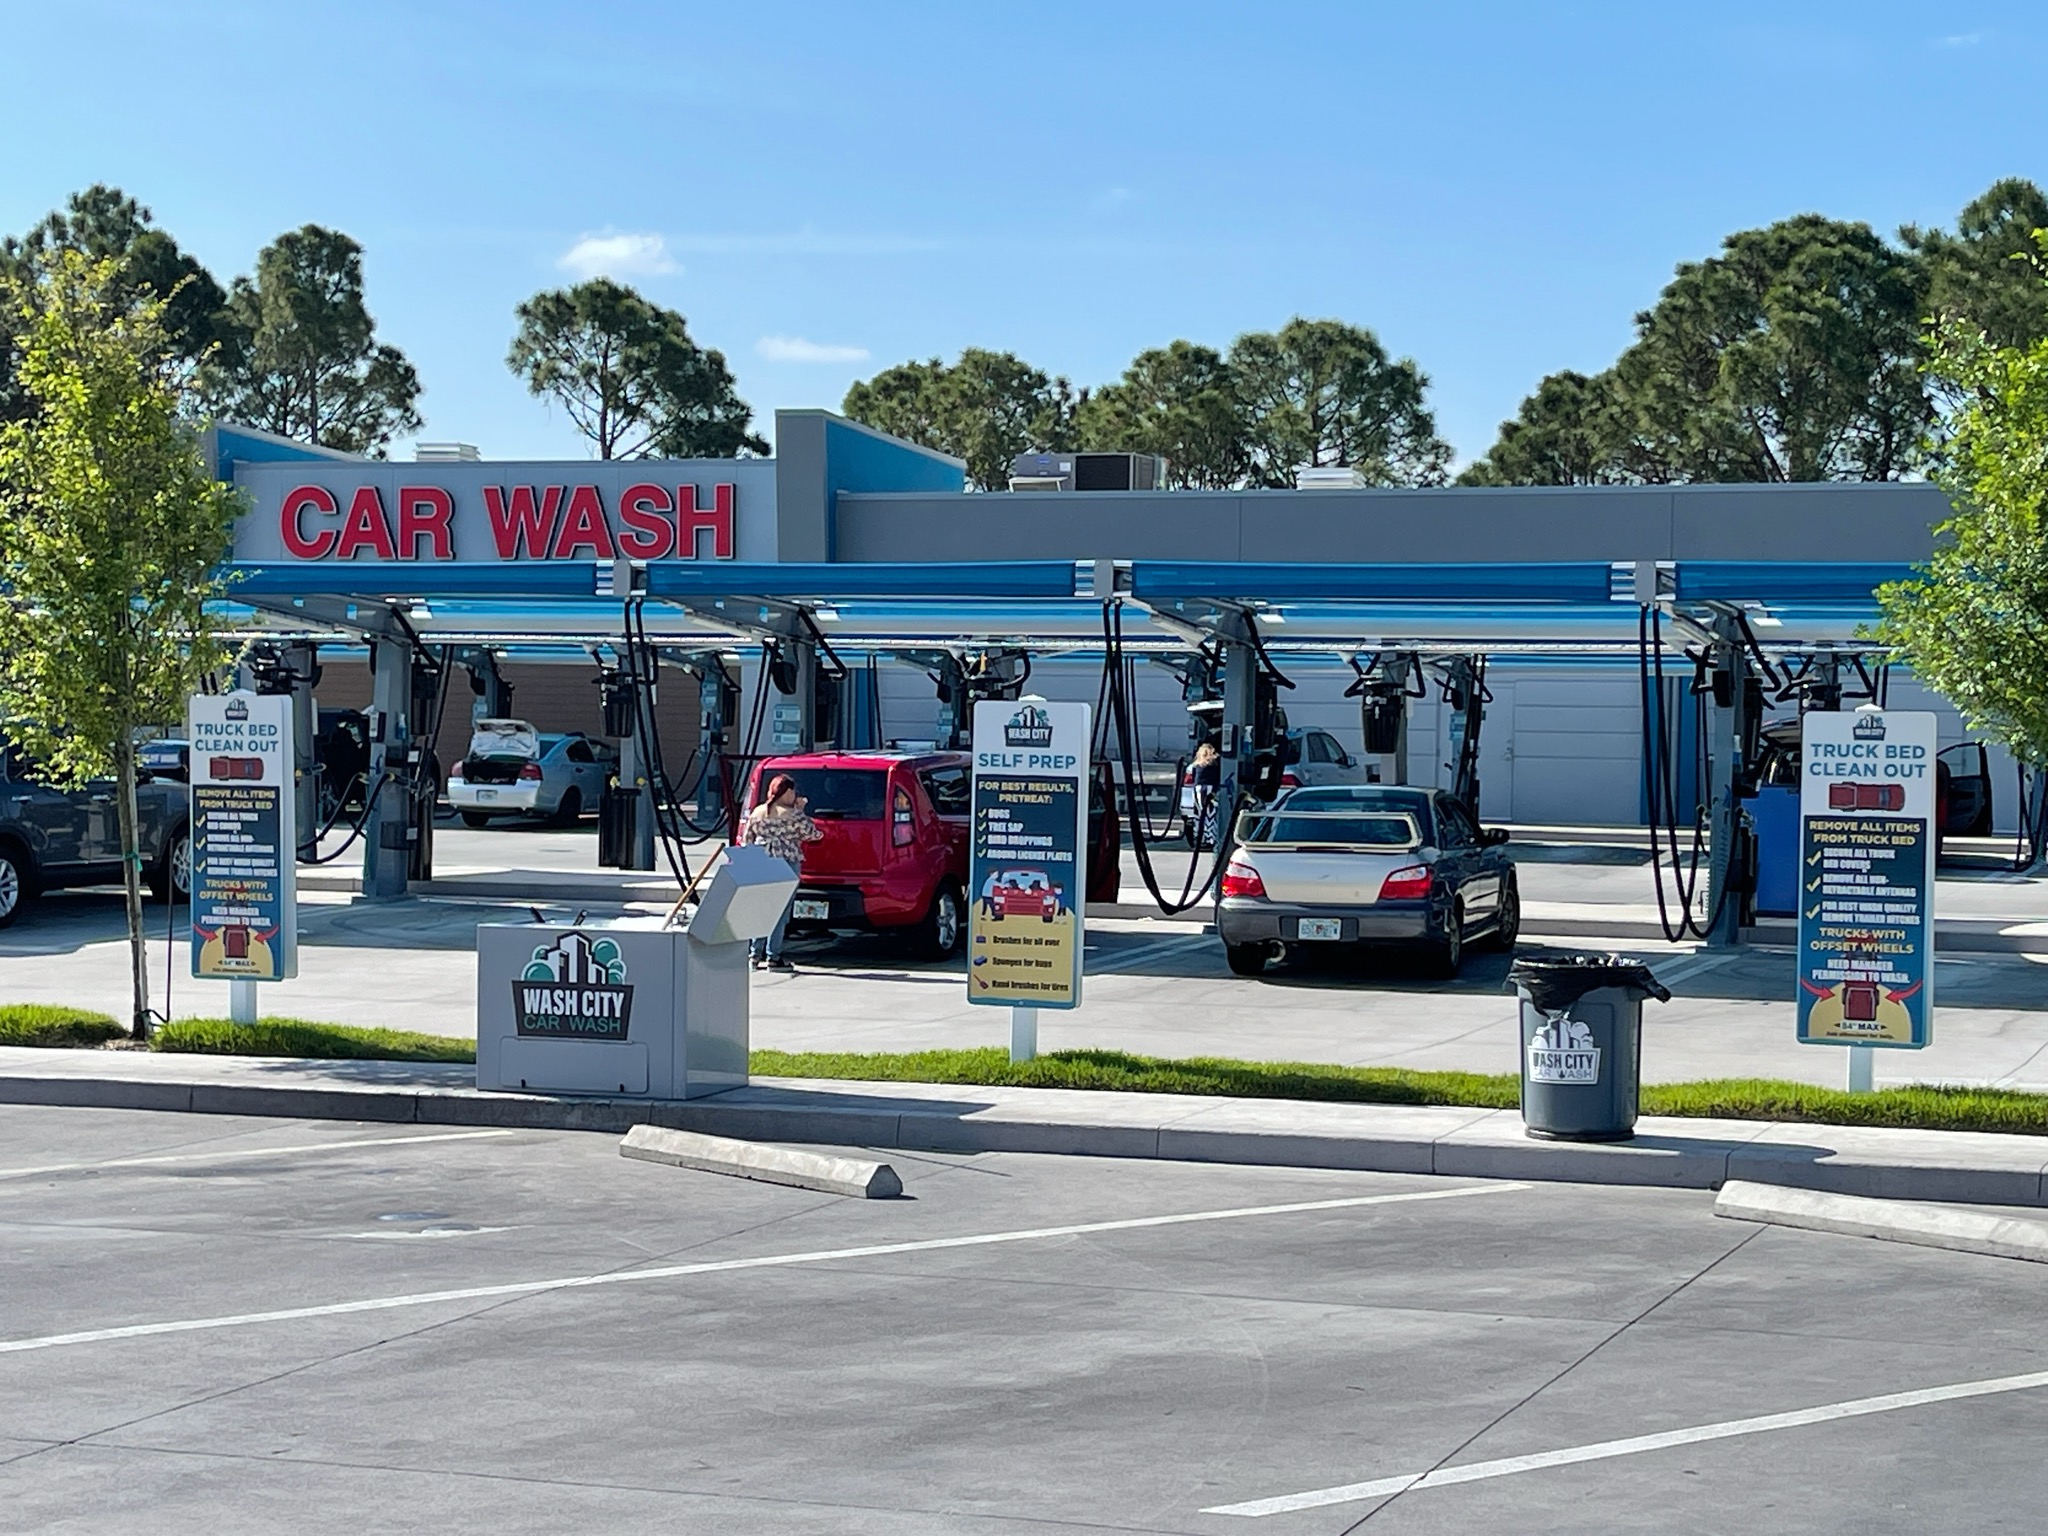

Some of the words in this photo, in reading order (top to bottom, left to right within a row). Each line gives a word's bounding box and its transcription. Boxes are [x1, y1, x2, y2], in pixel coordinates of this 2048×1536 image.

[280, 485, 453, 560] CAR
[482, 483, 735, 560] WASH
[195, 724, 244, 736] TRUCK
[249, 725, 278, 736] BED
[1032, 729, 1050, 740] CITY
[195, 740, 243, 751] CLEAN
[248, 741, 279, 752] OUT
[1810, 743, 1879, 758] TRUCK
[1885, 745, 1926, 759] BED
[978, 753, 1023, 767] SELF
[1029, 755, 1076, 769] PREP
[1809, 762, 1877, 777] CLEAN
[1884, 764, 1927, 778] OUT
[196, 789, 231, 798] REMOVE
[233, 790, 249, 798] ALL
[250, 790, 276, 799] ITEMS
[978, 781, 999, 790] FOR
[1001, 782, 1026, 791] BEST
[1028, 783, 1075, 794] RESULTS,
[200, 800, 224, 808] FROM
[225, 801, 253, 809] TRUCK
[999, 794, 1053, 804] PRETREAT:
[1809, 820, 1858, 831] REMOVE
[1860, 822, 1883, 832] ALL
[1885, 823, 1921, 833] ITEMS
[1813, 833, 1847, 843] FROM
[1849, 834, 1890, 845] TRUCK
[1891, 836, 1916, 845] BED
[206, 880, 241, 889] TRUCKS
[243, 881, 268, 889] WITH
[1819, 927, 1869, 939] TRUCKS
[1871, 929, 1906, 940] WITH
[1810, 941, 1859, 951] OFFSET
[1861, 942, 1915, 954] WHEELS
[523, 988, 578, 1015] WASH
[581, 990, 625, 1018] CITY
[523, 1014, 560, 1030] CAR
[569, 1016, 621, 1033] WASH
[1858, 1023, 1879, 1031] MAX
[1565, 1054, 1594, 1069] CITY
[1535, 1068, 1552, 1078] AR
[1556, 1069, 1592, 1079] WASH
